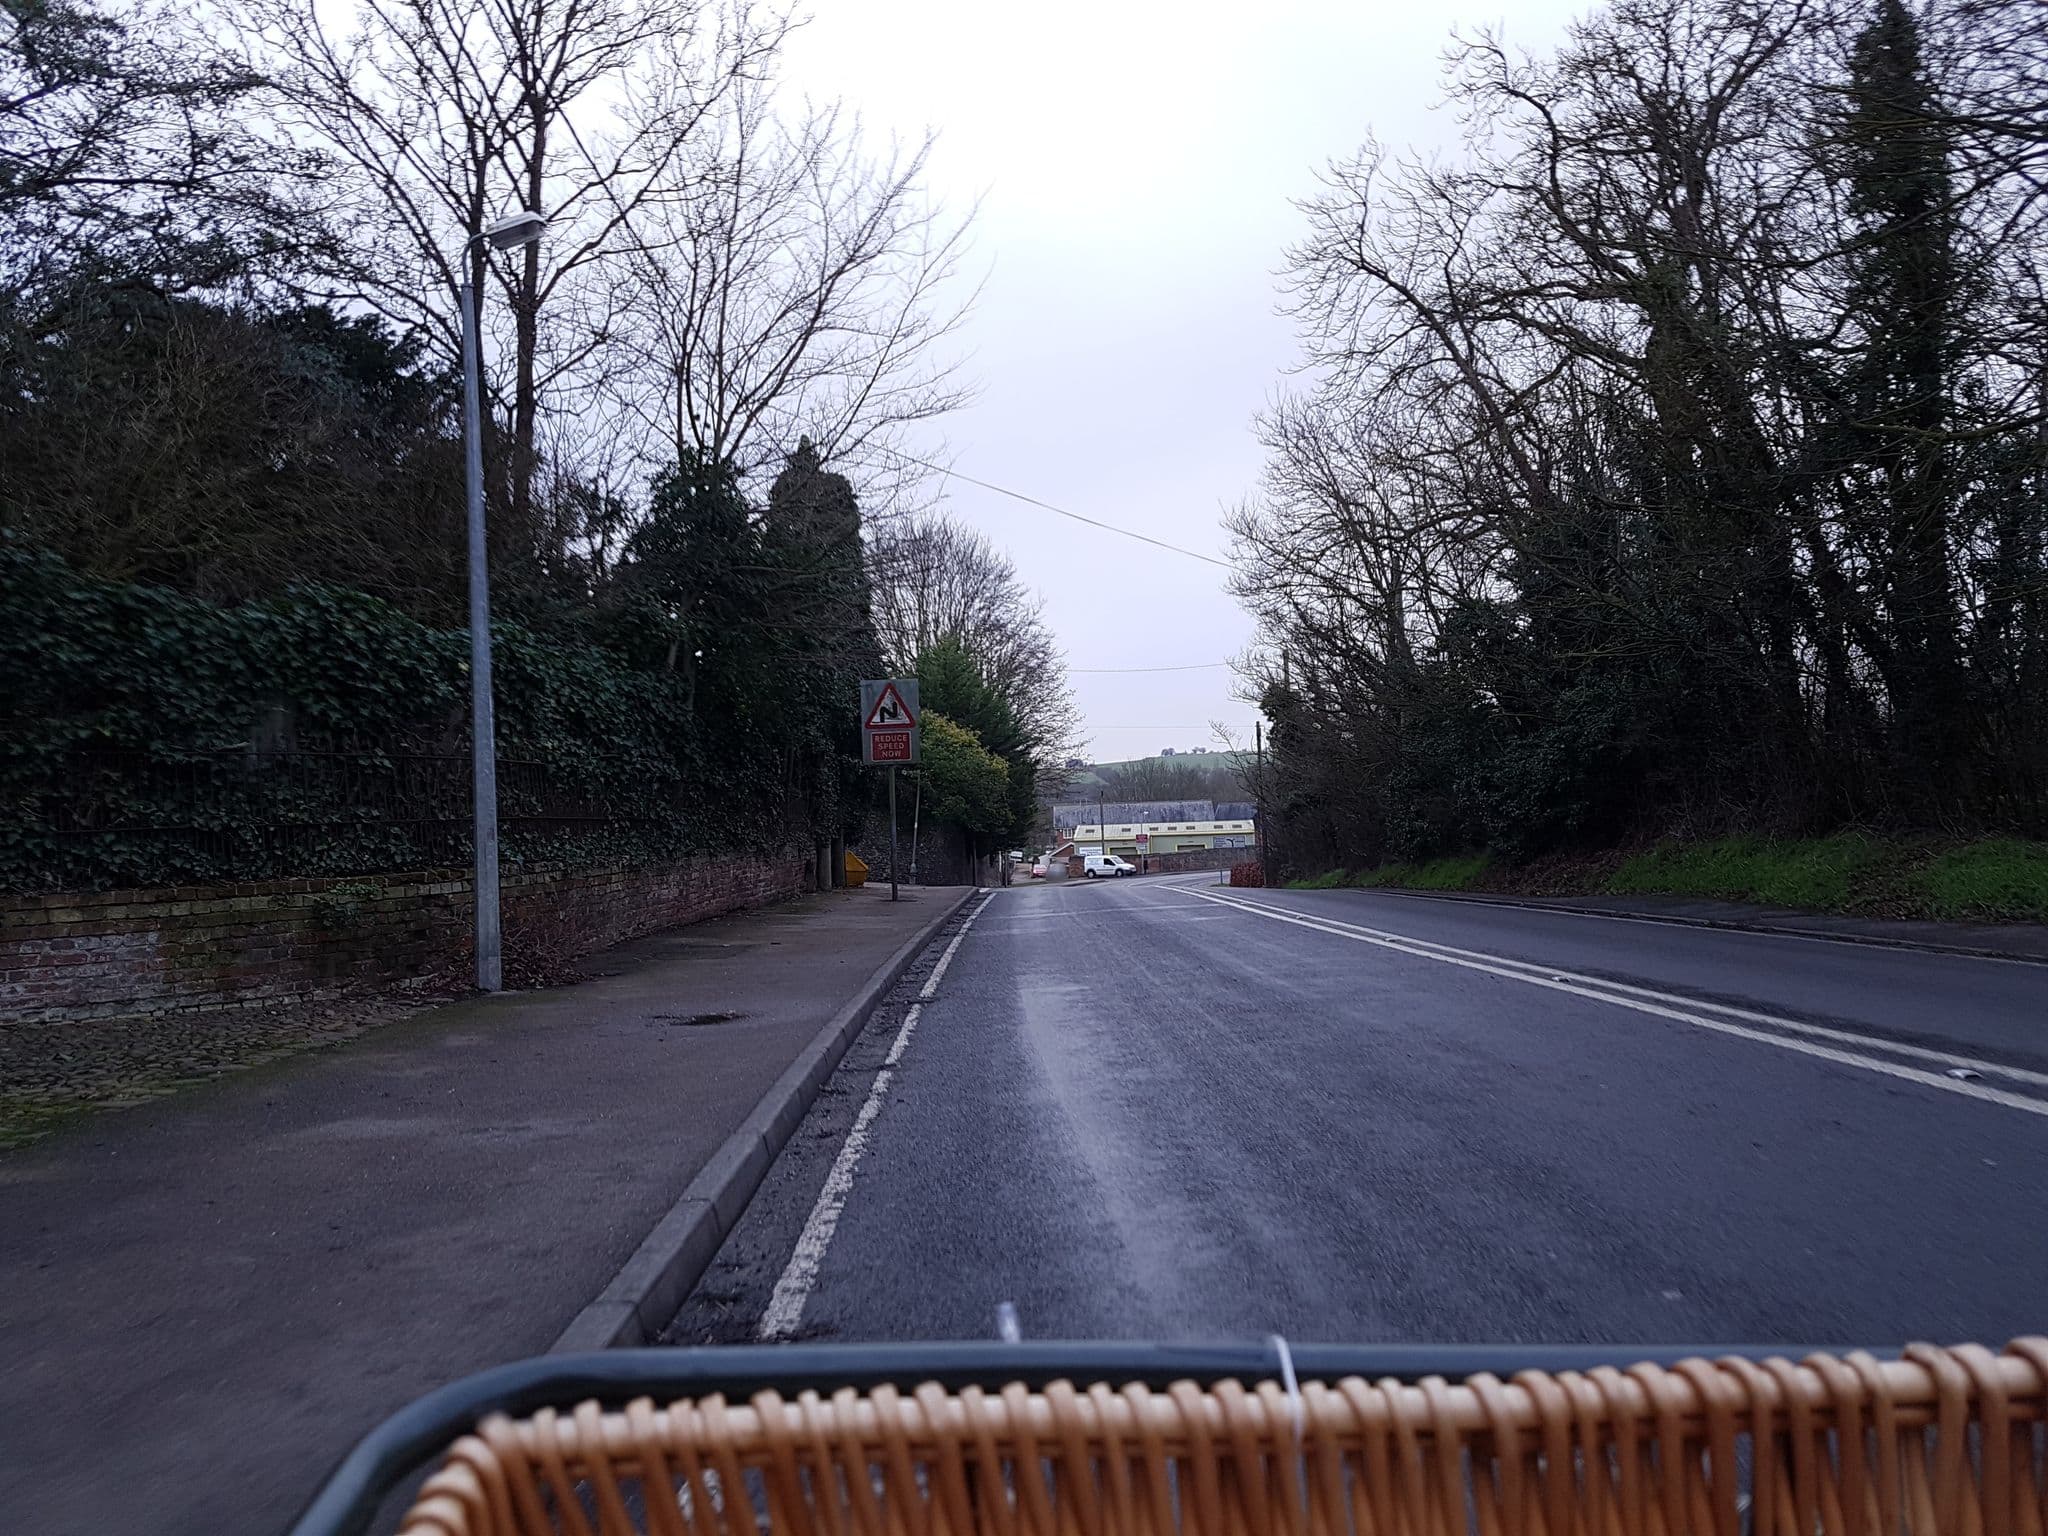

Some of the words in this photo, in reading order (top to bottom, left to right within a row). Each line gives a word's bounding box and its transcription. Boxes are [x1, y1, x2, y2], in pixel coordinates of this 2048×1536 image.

[874, 734, 908, 742] REDUCE
[878, 742, 904, 750] SPEED
[881, 750, 901, 758] NOW
